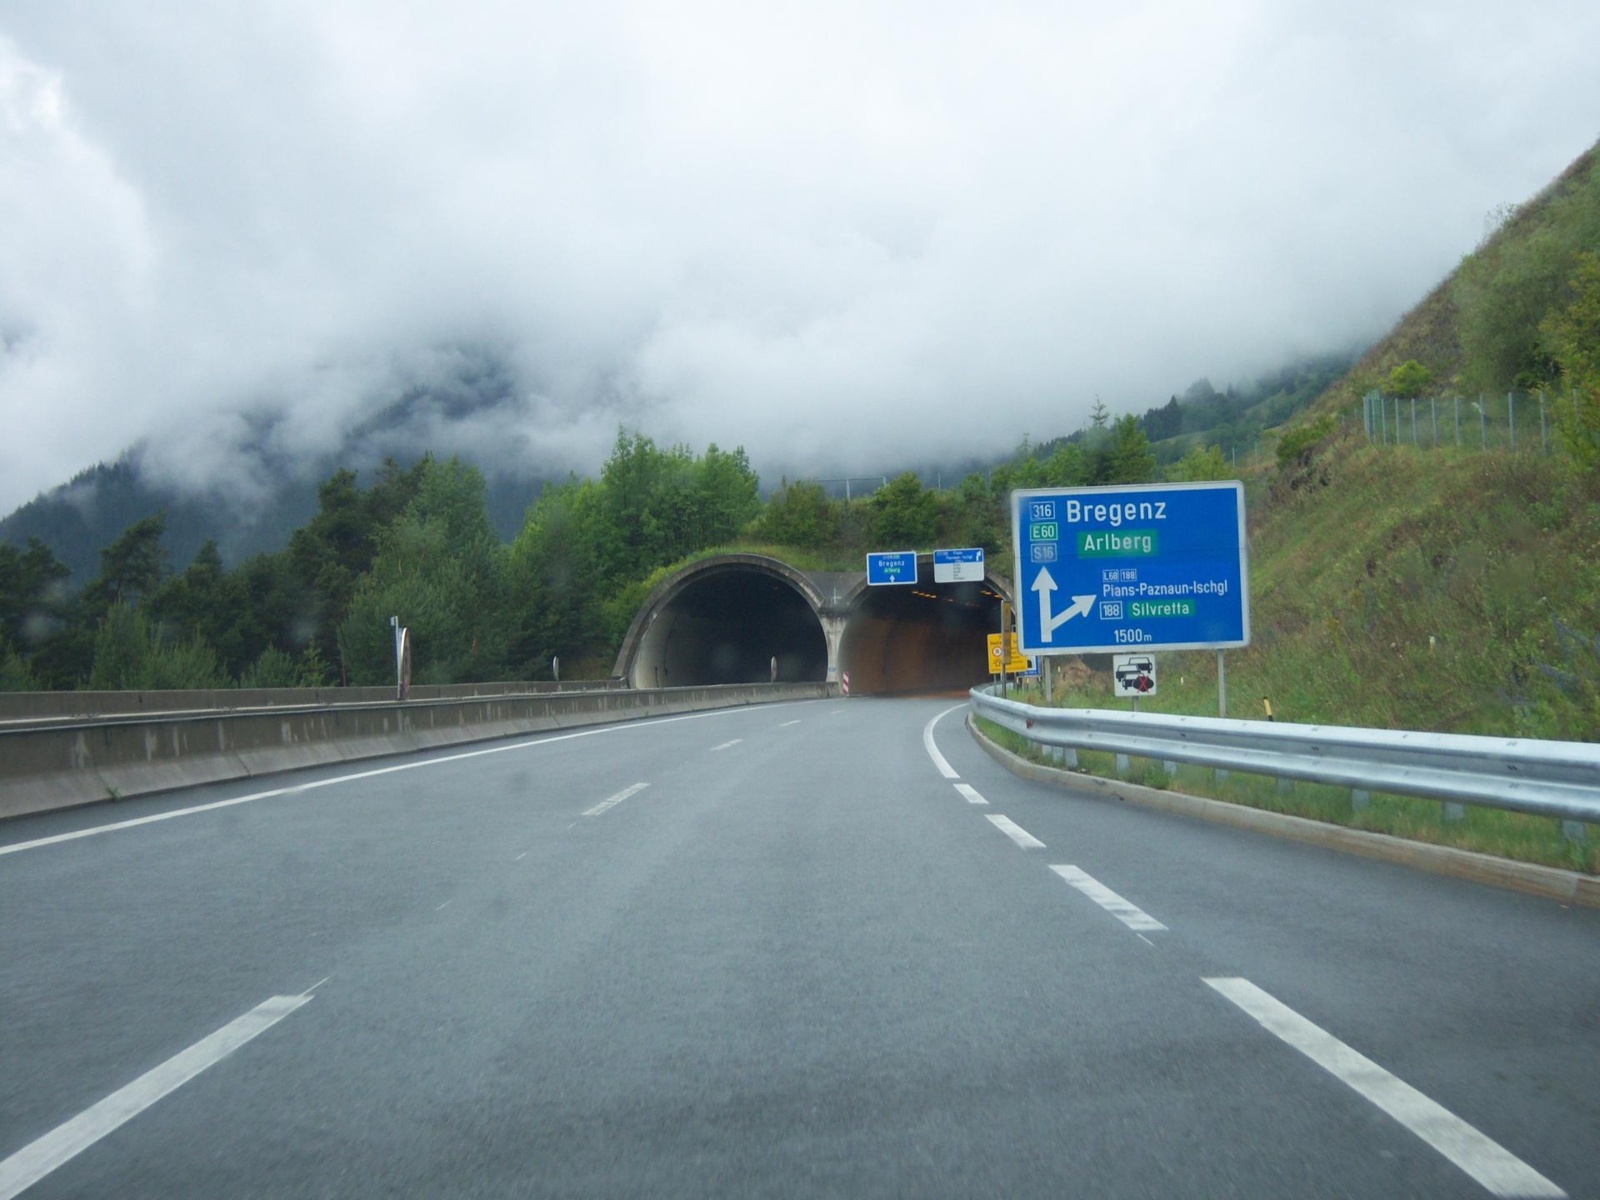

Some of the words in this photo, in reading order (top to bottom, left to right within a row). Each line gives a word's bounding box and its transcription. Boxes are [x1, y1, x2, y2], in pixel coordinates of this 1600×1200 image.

[1033, 504, 1052, 517] 316
[1067, 500, 1167, 526] Bregenz
[1033, 525, 1055, 538] E60
[1084, 534, 1152, 553] Arlberg
[1103, 579, 1228, 597] Pians-Paznaun-Ischgl
[1103, 604, 1120, 617] 188
[1132, 602, 1190, 616] Silvretta
